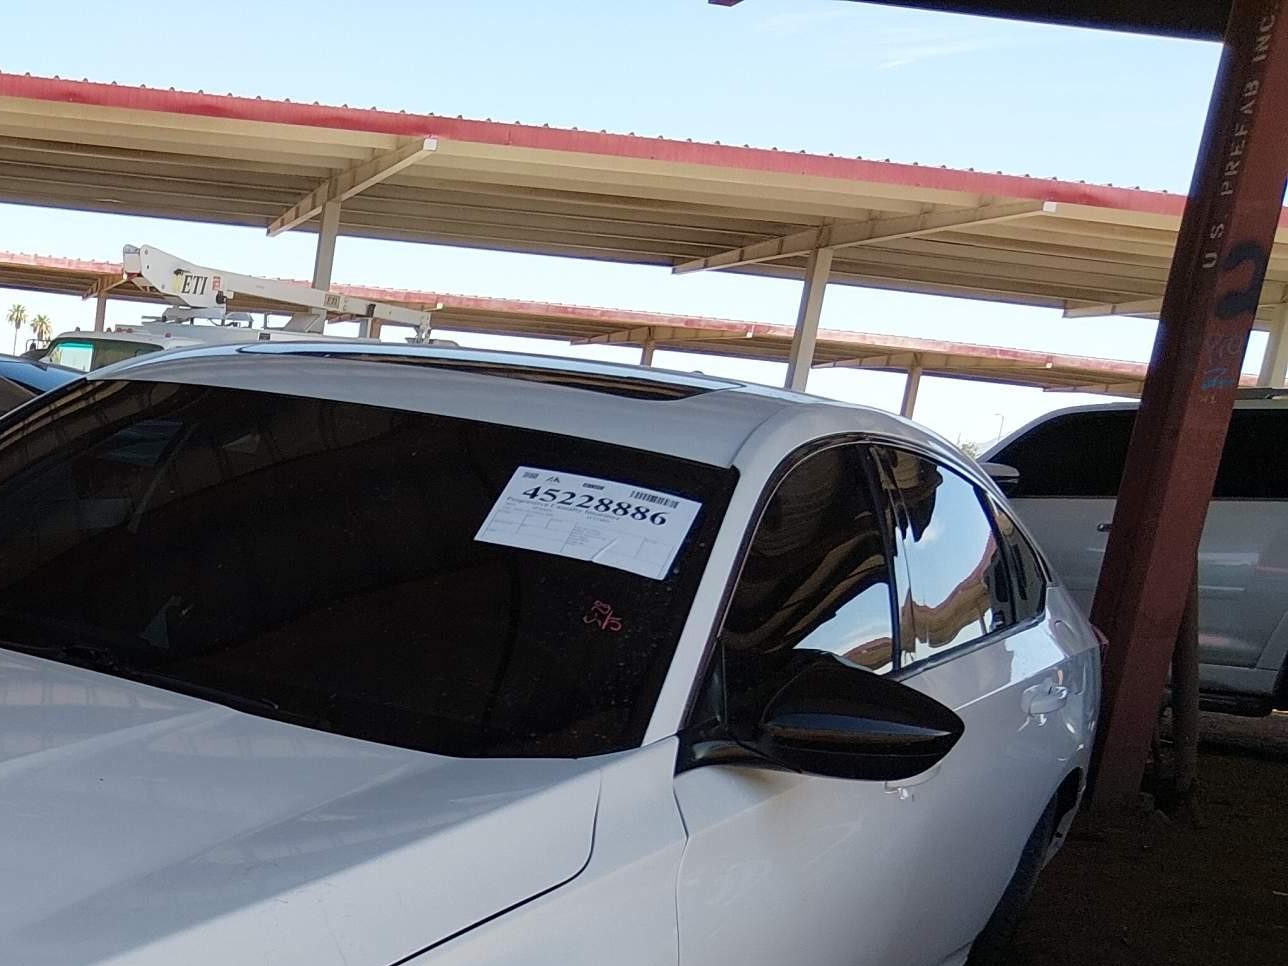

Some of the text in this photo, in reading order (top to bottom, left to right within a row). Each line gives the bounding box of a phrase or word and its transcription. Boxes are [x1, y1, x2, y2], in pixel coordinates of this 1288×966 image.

[1219, 79, 1260, 196] PREFAB
[181, 274, 209, 296] ETI
[1214, 239, 1267, 321] 2
[522, 485, 668, 527] 45228886
